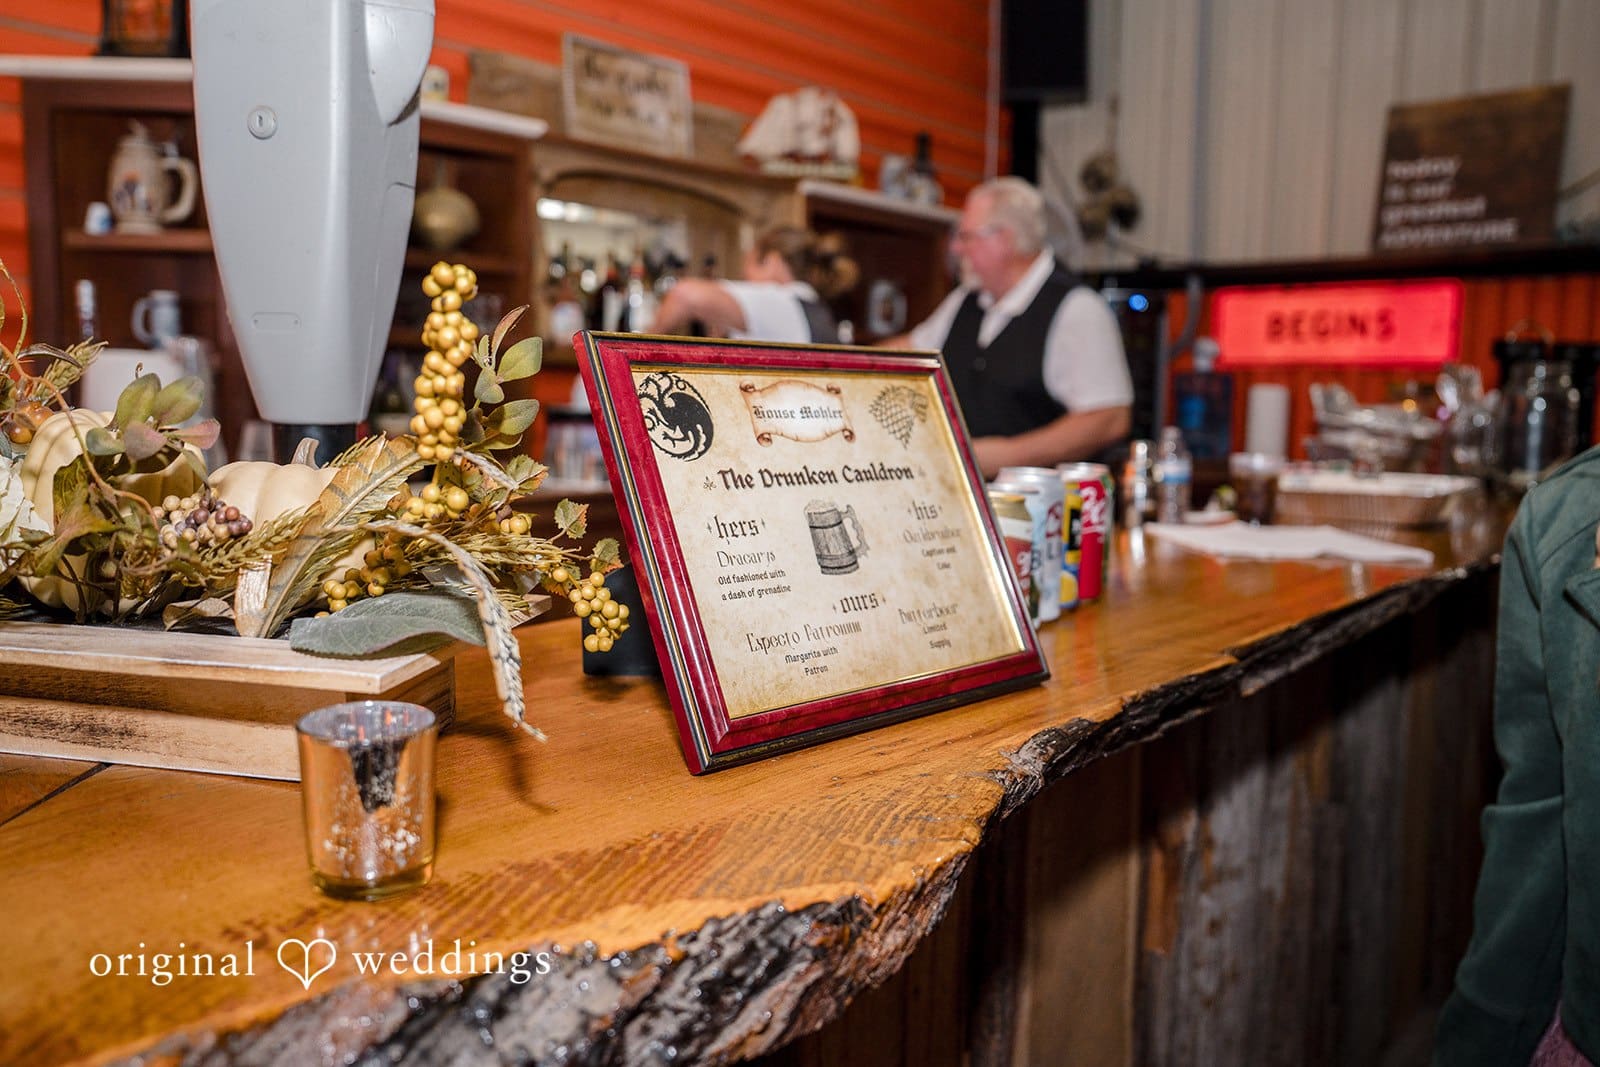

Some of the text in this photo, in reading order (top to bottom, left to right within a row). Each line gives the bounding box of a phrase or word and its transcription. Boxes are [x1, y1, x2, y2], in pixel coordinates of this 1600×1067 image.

[1264, 308, 1397, 343] BEGINS
[753, 405, 795, 421] House
[717, 462, 915, 491] The Drunken Cauldron
[911, 499, 939, 524] his
[713, 514, 760, 545] hers
[716, 549, 776, 568] Dracarys
[718, 568, 787, 586] Old fashioned with
[727, 590, 747, 601] dash
[747, 587, 756, 598] of
[756, 584, 792, 599] grenadine
[839, 592, 880, 614] ours
[745, 631, 801, 655] Expecto
[784, 645, 839, 664] Margarita with
[804, 664, 829, 676] Patron
